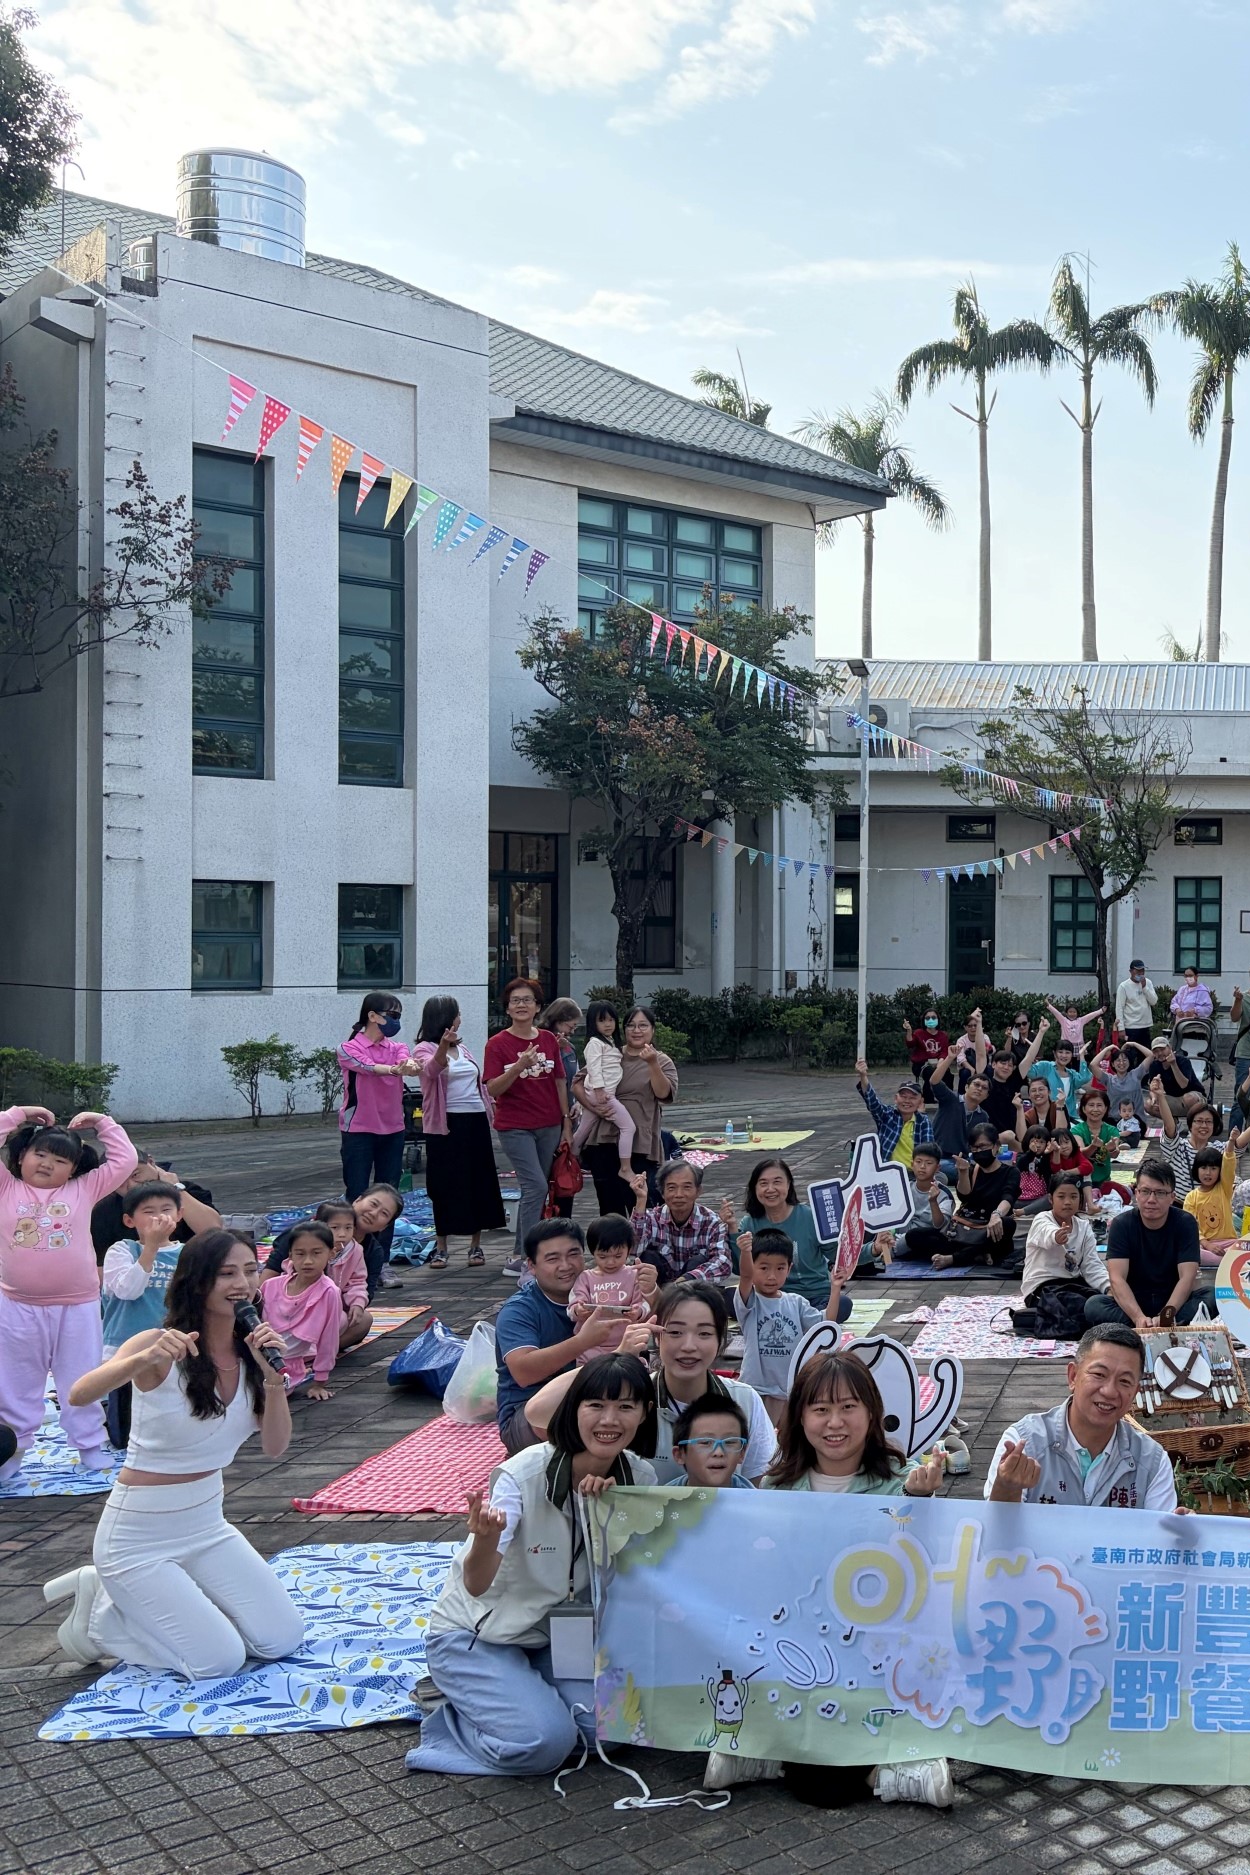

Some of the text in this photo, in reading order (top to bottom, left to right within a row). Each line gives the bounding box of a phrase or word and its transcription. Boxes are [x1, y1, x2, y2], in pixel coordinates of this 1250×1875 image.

[863, 1182, 892, 1212] 讚
[593, 1282, 622, 1291] HAPPY
[1217, 1290, 1240, 1298] TAINAN
[760, 1348, 791, 1356] TAIWAN
